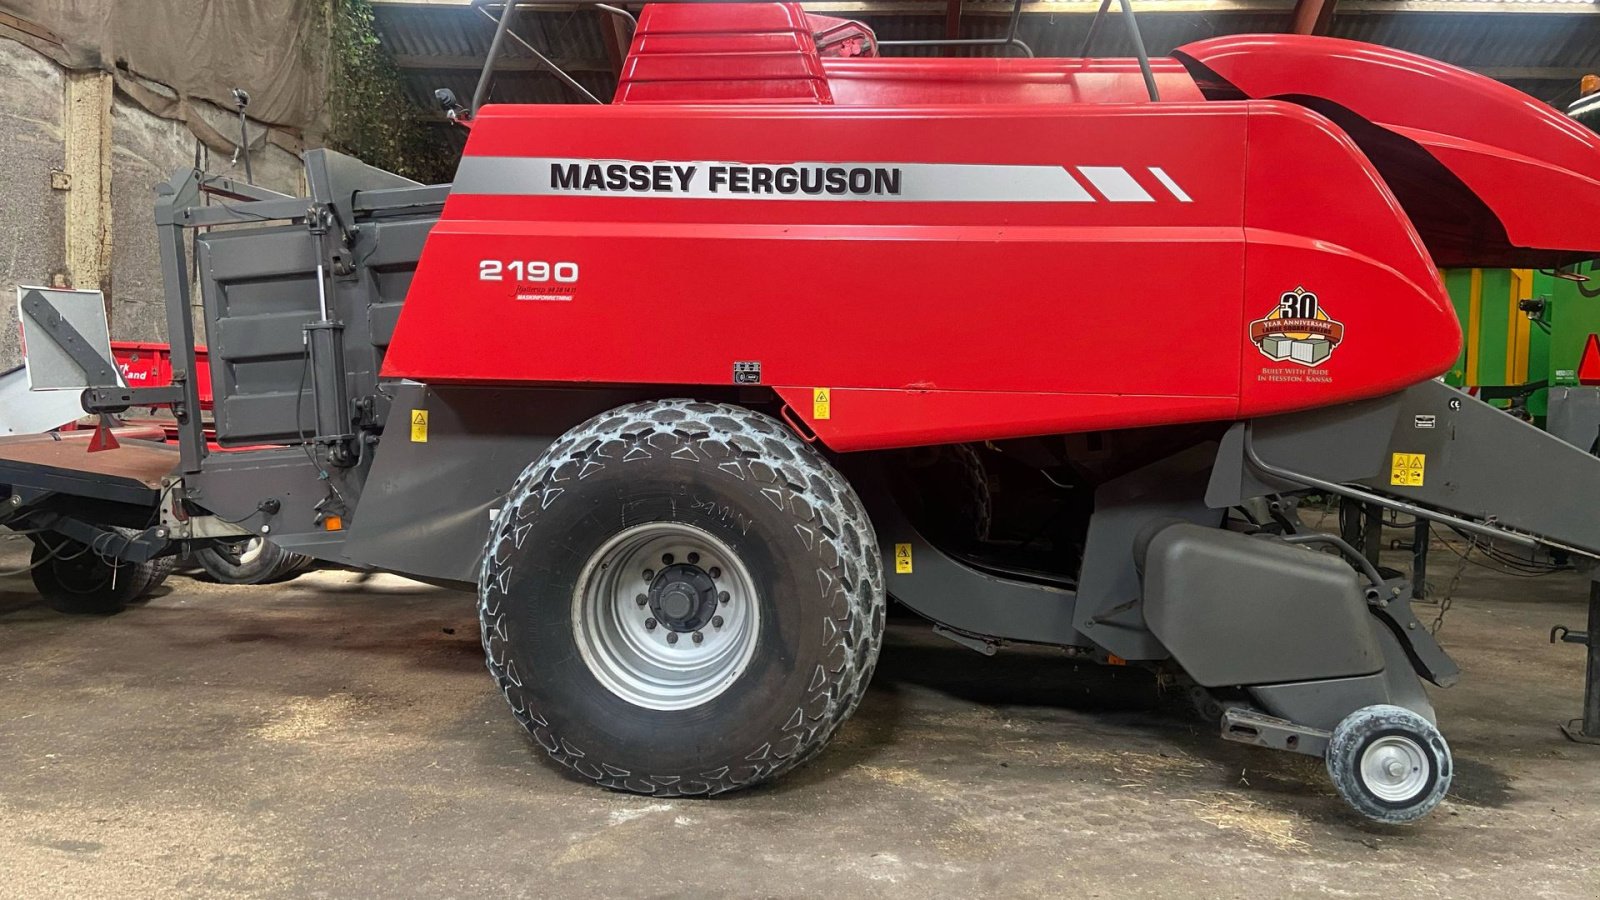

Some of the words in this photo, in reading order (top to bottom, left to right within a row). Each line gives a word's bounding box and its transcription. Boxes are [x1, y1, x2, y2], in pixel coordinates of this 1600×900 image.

[550, 163, 697, 192] MASSEY
[708, 166, 901, 195] FERGUSON
[479, 260, 579, 282] 2190
[1280, 293, 1316, 319] 30
[1263, 320, 1282, 328] YEAR
[1283, 319, 1332, 329] ANNIVERSARY
